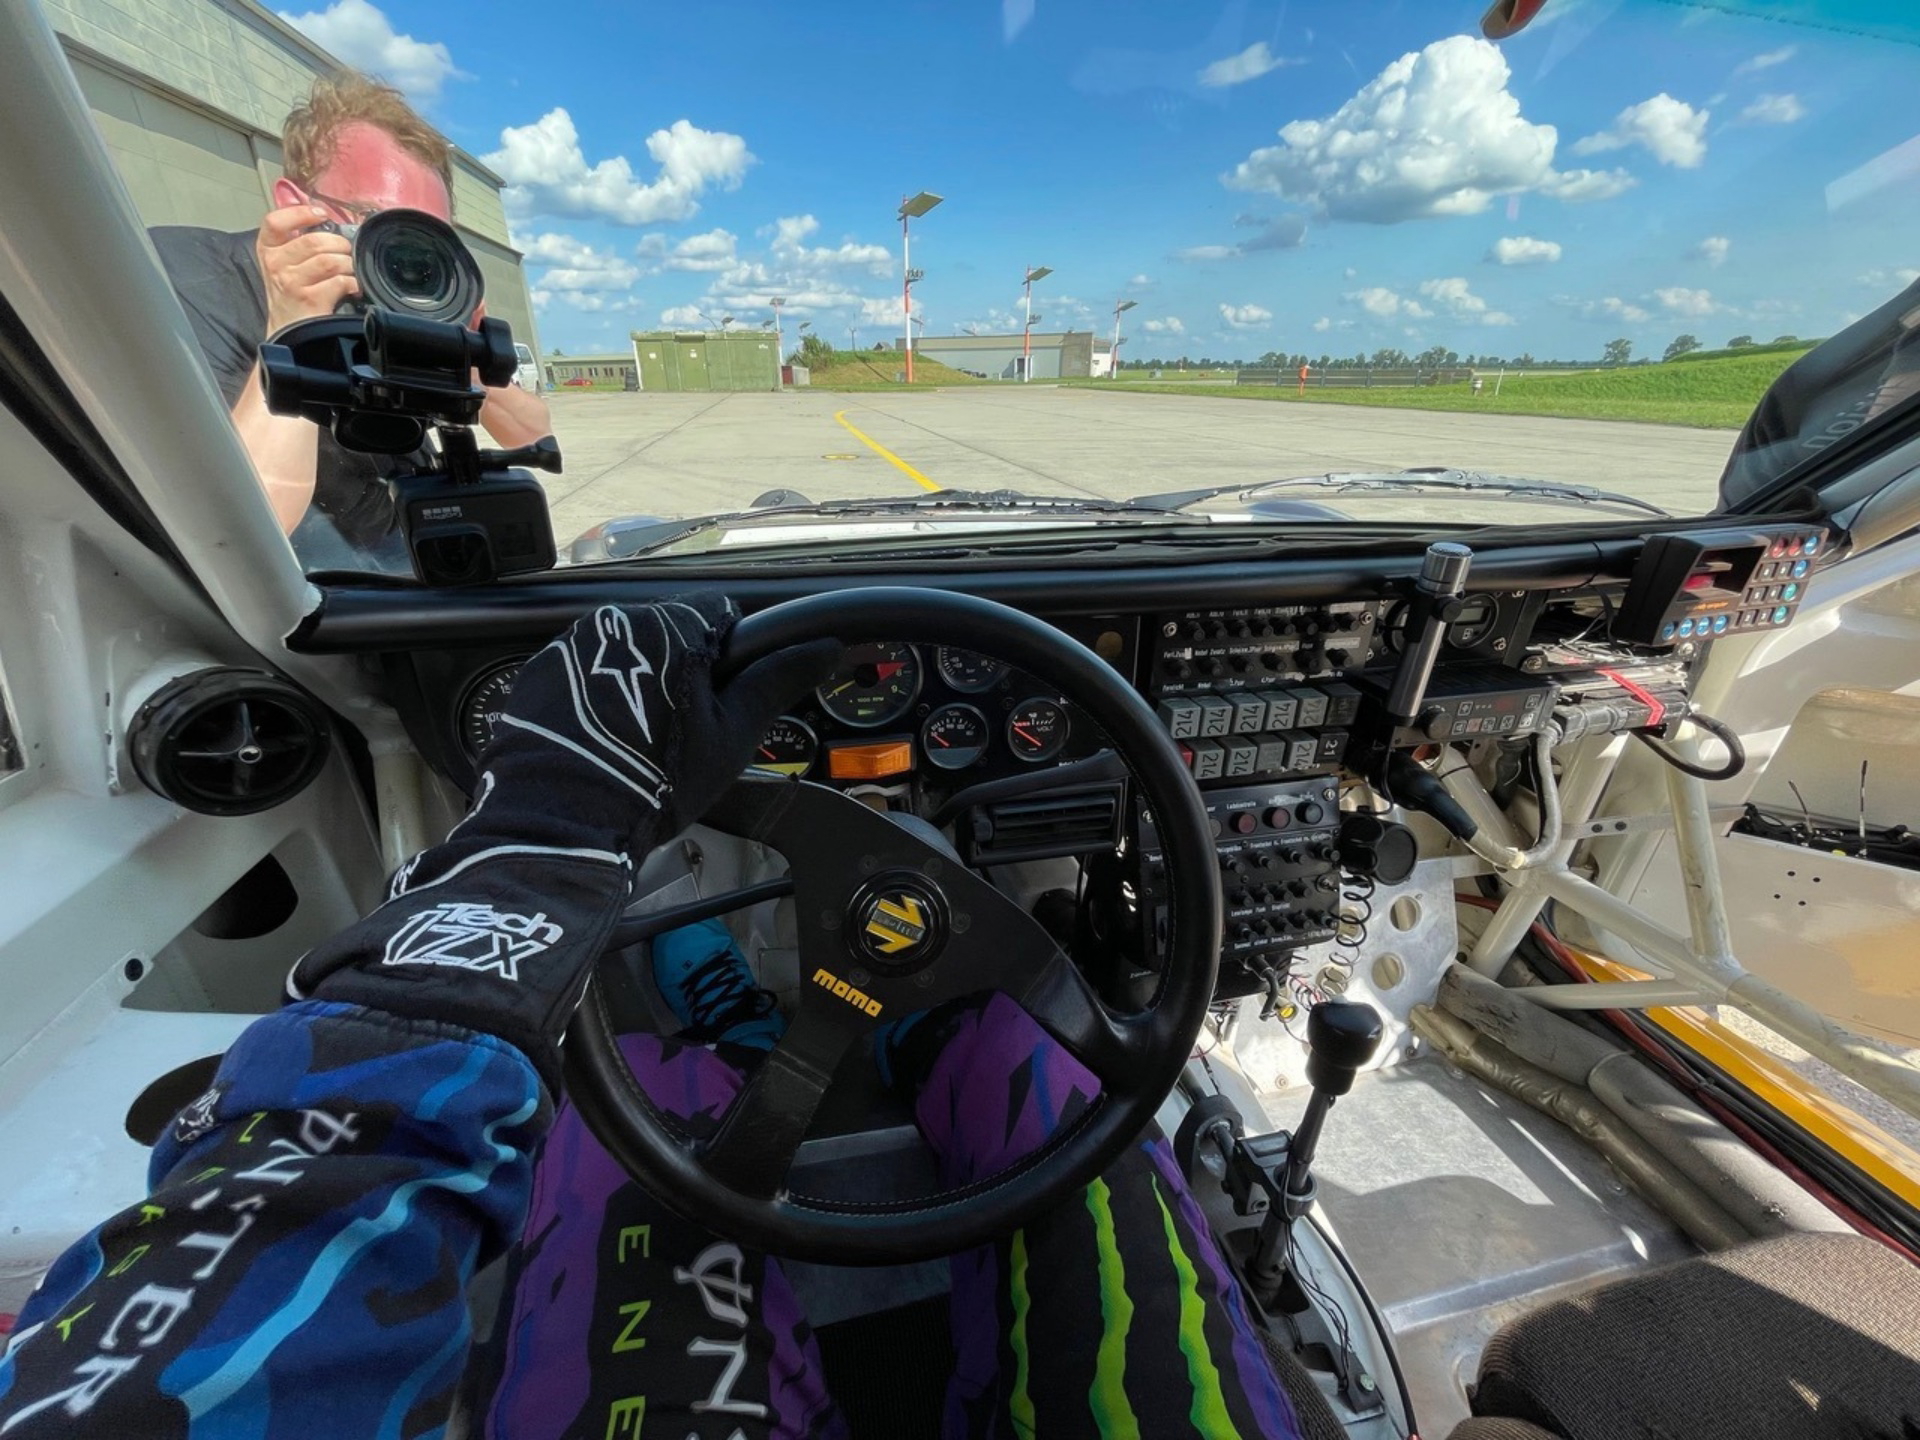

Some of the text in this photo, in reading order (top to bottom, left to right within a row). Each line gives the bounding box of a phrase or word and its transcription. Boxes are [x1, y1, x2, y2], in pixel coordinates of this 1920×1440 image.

[1175, 709, 1195, 738] 214
[1206, 708, 1226, 735] 214
[1240, 704, 1260, 733] 214
[1272, 702, 1291, 729] 214
[1201, 751, 1219, 778] 214
[1232, 749, 1251, 775] 214
[1294, 742, 1313, 768] 214
[437, 902, 564, 948] Tech
[812, 968, 883, 1018] momo
